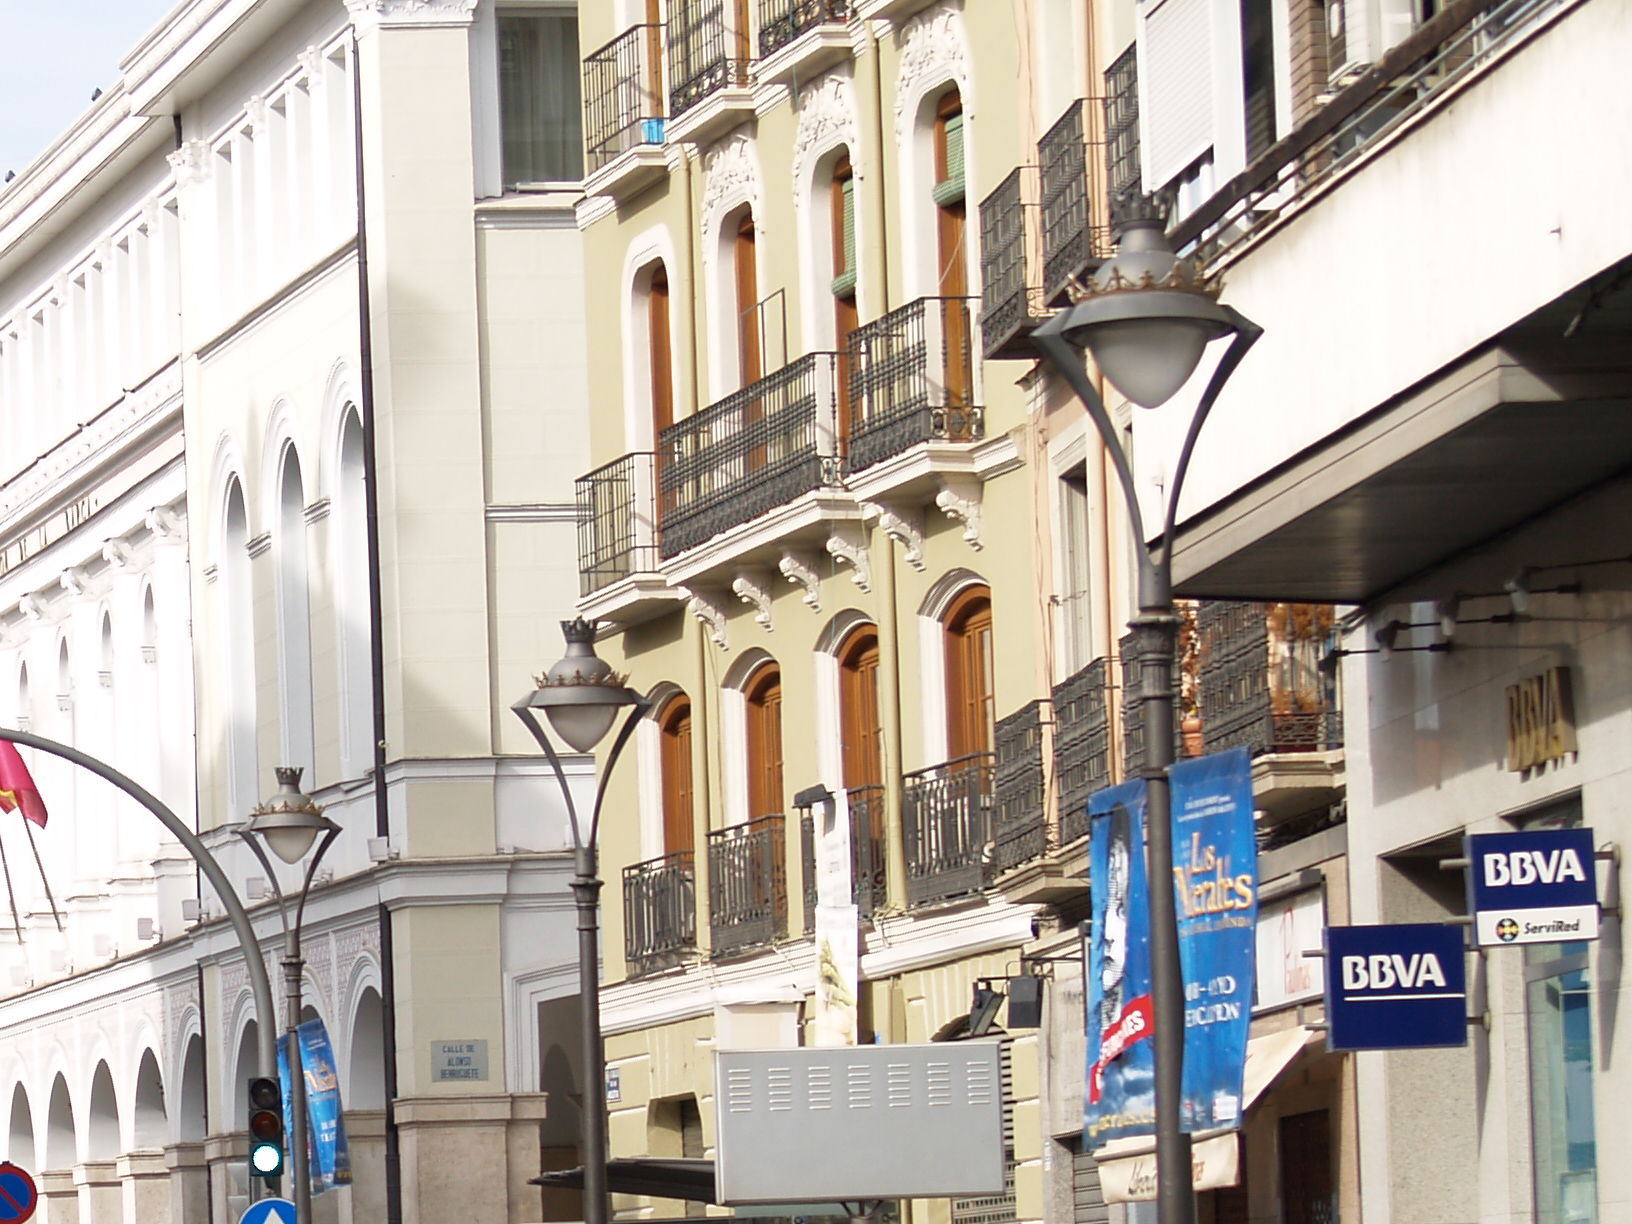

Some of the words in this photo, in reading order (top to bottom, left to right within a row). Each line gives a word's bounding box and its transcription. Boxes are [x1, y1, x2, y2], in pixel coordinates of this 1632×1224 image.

[1484, 848, 1585, 887] BBVA
[1524, 919, 1580, 935] ServiRed
[1342, 953, 1446, 990] BBVA
